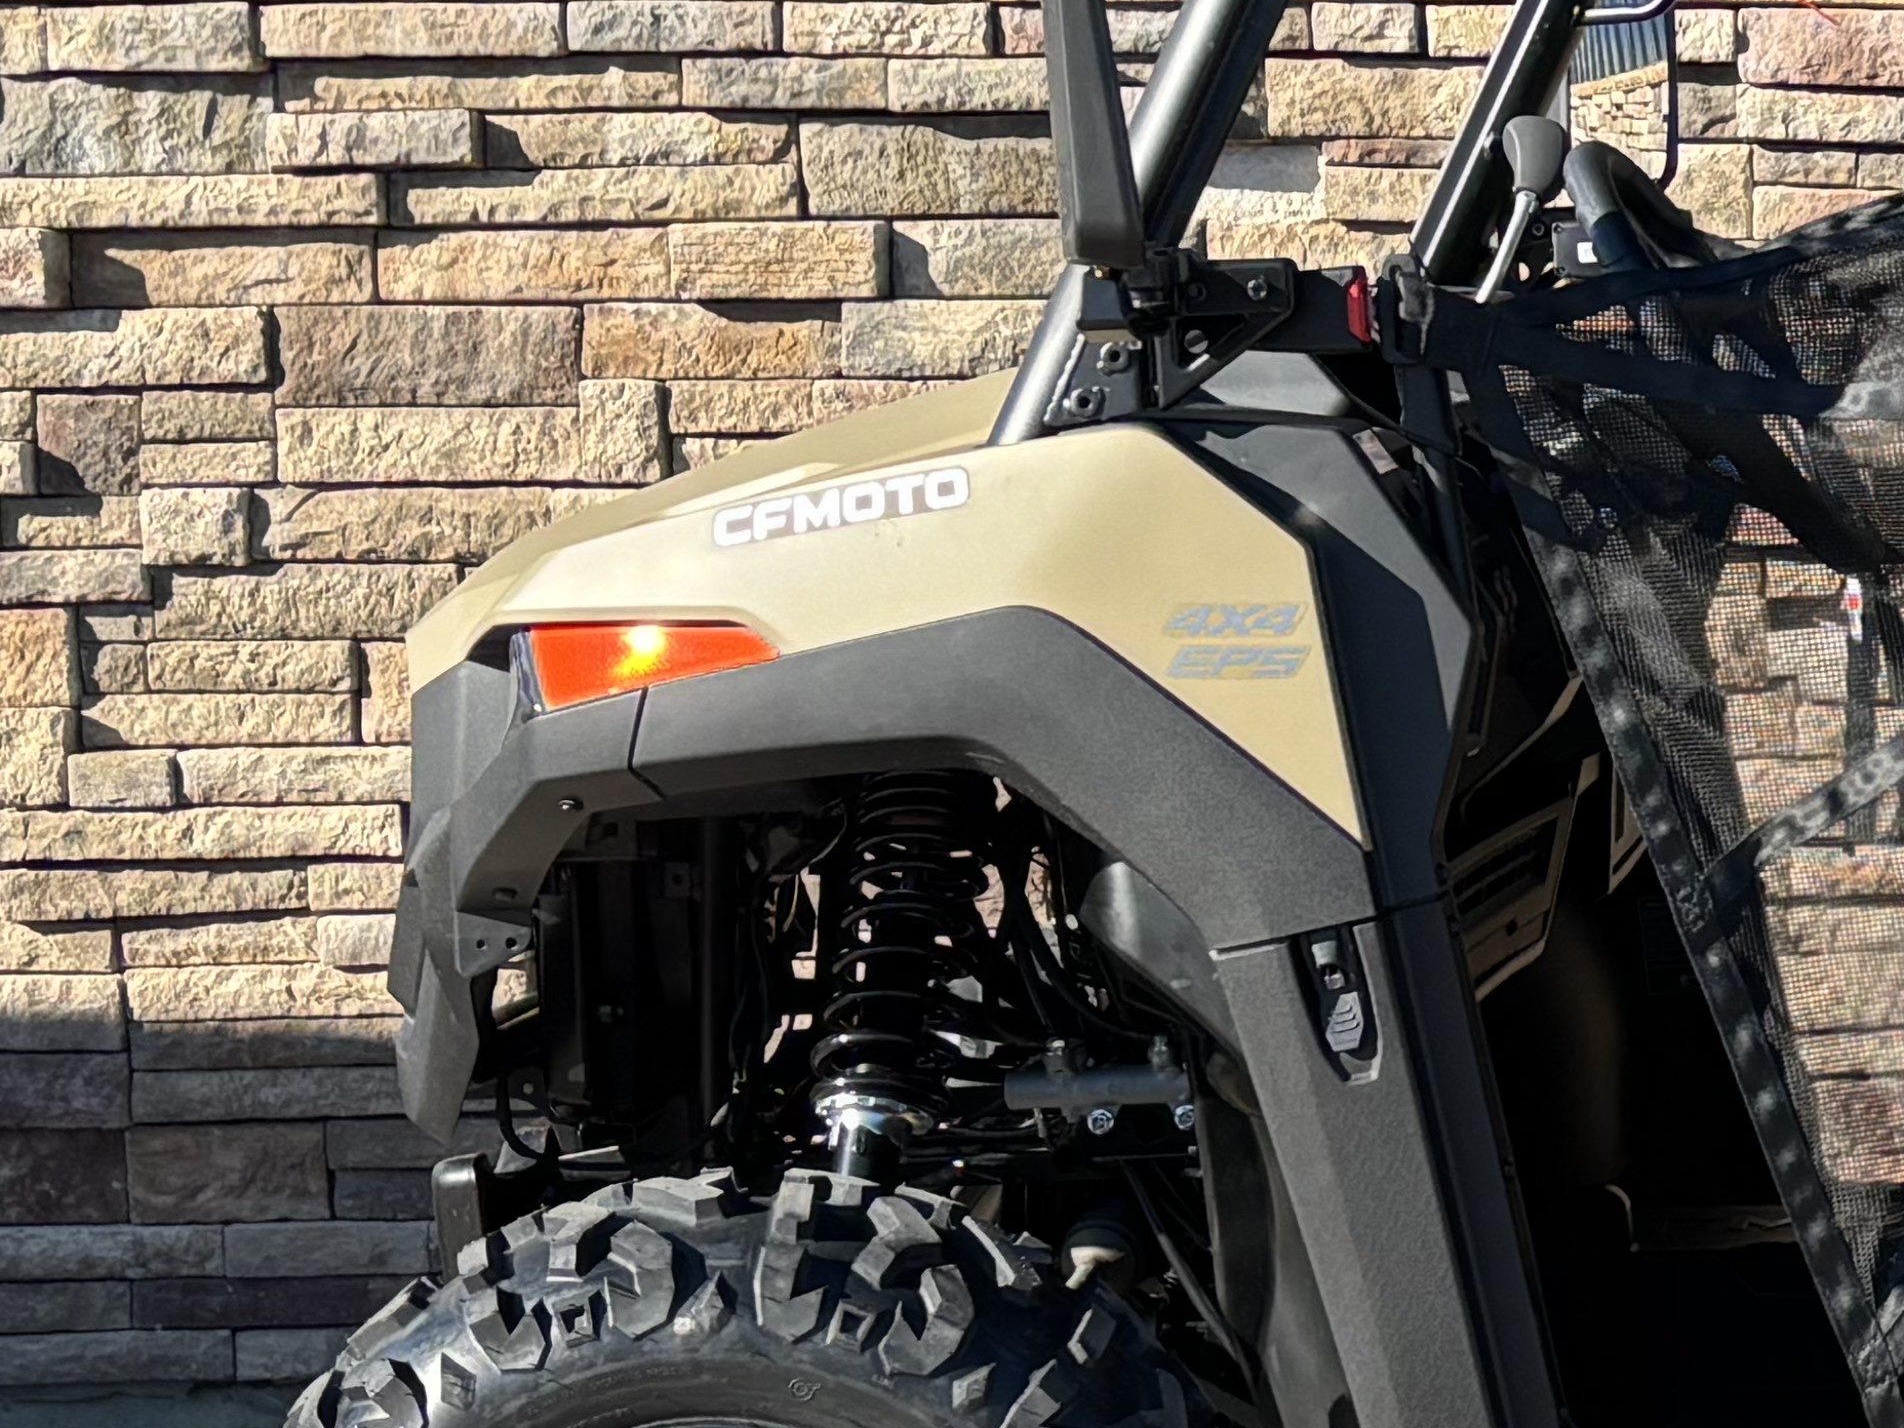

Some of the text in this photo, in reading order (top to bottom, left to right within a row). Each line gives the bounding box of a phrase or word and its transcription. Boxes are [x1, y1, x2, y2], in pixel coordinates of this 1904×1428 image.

[713, 468, 970, 547] CFMOTO
[1167, 603, 1302, 638] 4X4
[1166, 646, 1308, 679] EPS
